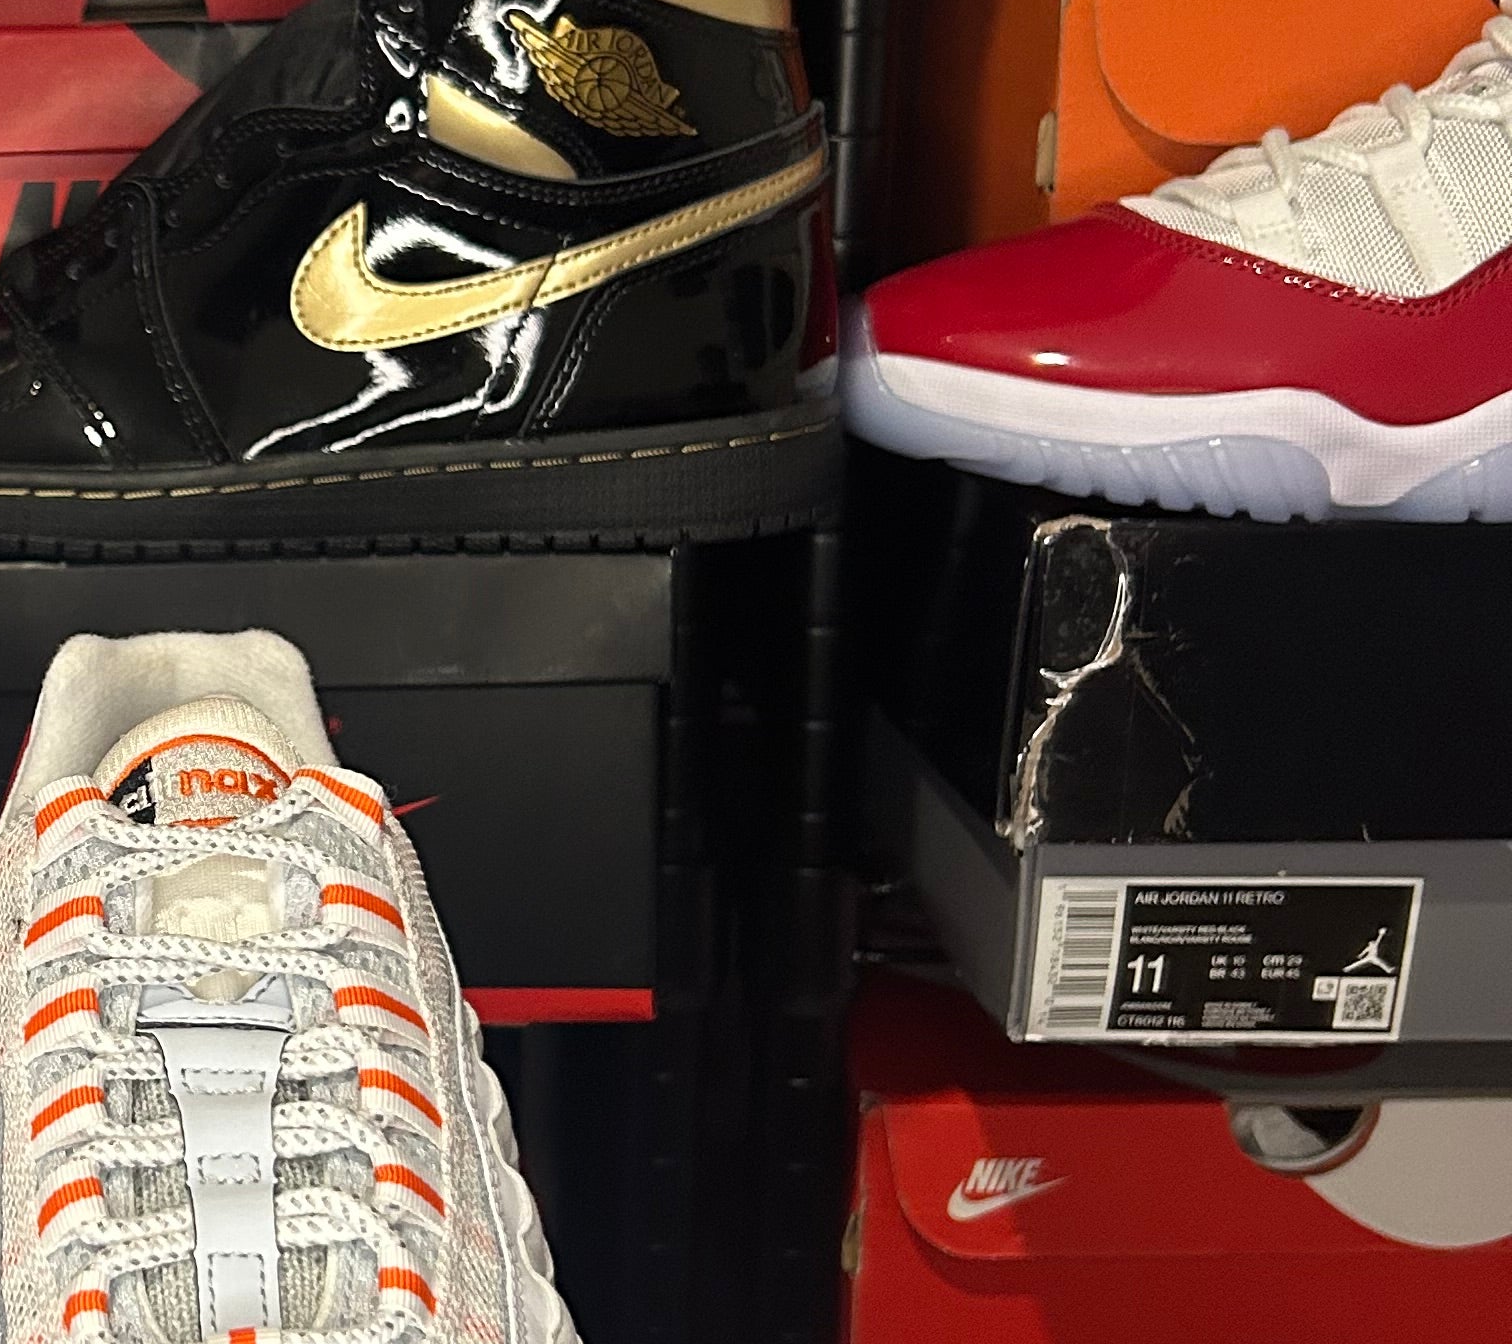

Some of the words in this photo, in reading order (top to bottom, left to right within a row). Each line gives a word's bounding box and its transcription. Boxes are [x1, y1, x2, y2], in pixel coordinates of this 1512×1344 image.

[555, 29, 601, 51] AIR
[1127, 954, 1166, 994] 11
[964, 1156, 1046, 1194] NIKE
